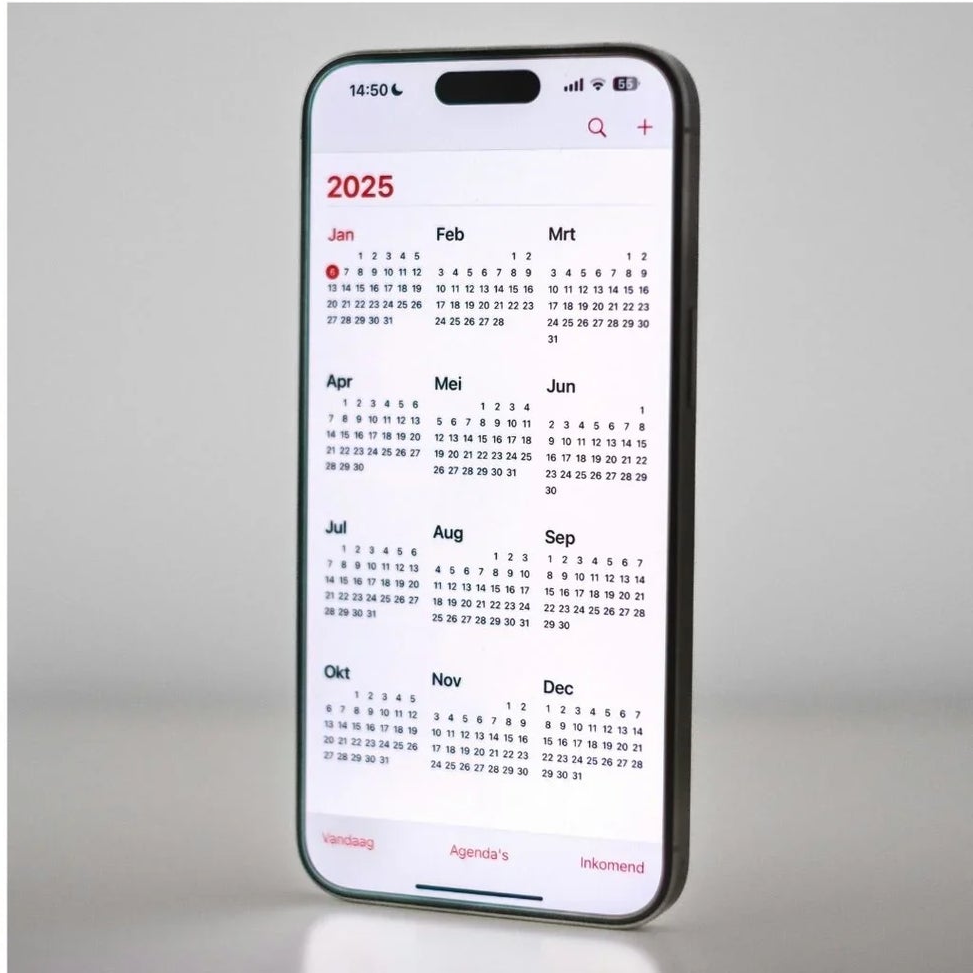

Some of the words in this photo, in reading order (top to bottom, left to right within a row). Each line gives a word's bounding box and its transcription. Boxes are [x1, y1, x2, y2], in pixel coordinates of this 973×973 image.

[350, 83, 388, 97] 14:50
[327, 175, 394, 198] 2025
[328, 228, 354, 242] Jan
[437, 227, 465, 241] Feb
[549, 227, 576, 241] Mrt
[372, 252, 377, 260] 2
[386, 252, 392, 260] 3
[400, 252, 406, 260] 4
[414, 252, 420, 260] 5
[526, 252, 532, 261] 2
[641, 252, 647, 261] 2
[438, 268, 444, 277] 3
[452, 268, 459, 276] 4
[467, 268, 473, 277] 5
[481, 268, 488, 277] 6
[496, 268, 502, 277] 7
[510, 268, 517, 277] 8
[525, 268, 532, 277] 9
[548, 285, 559, 294] 10
[564, 285, 572, 293] 11
[578, 285, 588, 294] 12
[593, 285, 604, 294] 13
[608, 286, 619, 294] 14
[624, 285, 634, 295] 15
[639, 286, 649, 295] 16
[327, 299, 338, 309] 20
[341, 300, 351, 309] 21
[355, 300, 366, 309] 22
[369, 300, 380, 309] 23
[383, 300, 394, 309] 24
[397, 300, 408, 309] 25
[411, 300, 422, 309] 26
[435, 317, 446, 325] 24
[449, 317, 461, 326] 25
[464, 317, 475, 326] 26
[479, 317, 489, 326] 27
[493, 317, 504, 326] 28
[548, 335, 558, 344] 31
[326, 374, 353, 391] Apr
[435, 376, 462, 391] Mei
[546, 379, 575, 393] Jun
[357, 398, 362, 407] 2
[370, 399, 376, 408] 3
[384, 400, 390, 408] 4
[398, 400, 404, 409] 5
[412, 400, 419, 409] 6
[495, 402, 500, 411] 2
[509, 403, 515, 411] 3
[524, 403, 530, 411] 4
[549, 420, 555, 429] 2
[564, 420, 570, 429] 3
[578, 421, 585, 429] 4
[594, 421, 600, 430] 5
[608, 422, 615, 431] 6
[624, 422, 630, 431] 7
[639, 423, 645, 432] 8
[435, 433, 444, 442] 12
[449, 434, 459, 442] 13
[463, 434, 473, 442] 14
[478, 435, 488, 443] 15
[492, 435, 502, 444] 16
[507, 435, 517, 444] 17
[521, 436, 532, 445] 18
[546, 453, 557, 462] 16
[561, 454, 571, 462] 17
[576, 454, 587, 463] 18
[591, 454, 602, 464] 19
[605, 455, 617, 464] 20
[621, 455, 631, 464] 21
[636, 456, 647, 465] 22
[545, 486, 557, 495] 30
[325, 520, 347, 534] Jul
[433, 525, 463, 543] Aug
[545, 530, 575, 548] Sep
[355, 545, 361, 554] 2
[369, 546, 375, 555] 3
[383, 547, 389, 555] 4
[397, 547, 403, 556] 5
[411, 548, 417, 557] 6
[508, 552, 513, 561] 2
[522, 553, 528, 562] 3
[562, 555, 568, 564] 2
[577, 556, 583, 565] 3
[592, 557, 598, 565] 4
[607, 557, 613, 566] 5
[622, 558, 628, 567] 6
[637, 559, 643, 567] 7
[435, 565, 441, 573] 4
[449, 566, 455, 575] 5
[463, 567, 470, 575] 6
[478, 567, 484, 576] 7
[492, 568, 499, 577] 8
[507, 569, 513, 578] 9
[520, 570, 530, 579] 10
[544, 604, 555, 613] 22
[559, 604, 570, 613] 23
[573, 605, 585, 614] 24
[588, 606, 600, 615] 25
[603, 607, 615, 616] 26
[619, 608, 630, 617] 27
[633, 608, 645, 618] 28
[432, 613, 443, 622] 25
[446, 614, 458, 623] 26
[461, 615, 472, 624] 27
[475, 616, 487, 625] 28
[490, 616, 501, 626] 29
[504, 617, 516, 627] 30
[519, 618, 529, 627] 31
[544, 620, 555, 629] 29
[558, 620, 570, 630] 30
[324, 664, 350, 680] Okt
[432, 672, 462, 687] Nov
[543, 680, 574, 695] Dec
[368, 691, 374, 700] 2
[382, 693, 388, 701] 3
[410, 694, 416, 703] 5
[521, 702, 526, 711] 2
[560, 705, 566, 714] 2
[575, 706, 581, 715] 3
[590, 708, 596, 716] 4
[605, 708, 611, 717] 5
[619, 709, 626, 718] 6
[635, 710, 641, 719] 7
[432, 728, 442, 737] 10
[446, 729, 455, 737] 11
[460, 730, 470, 739] 12
[475, 731, 485, 741] 13
[489, 733, 499, 741] 14
[504, 734, 514, 743] 15
[518, 735, 528, 744] 16
[542, 769, 553, 778] 29
[557, 770, 568, 779] 30
[572, 771, 582, 780] 31
[322, 831, 375, 850] Vandaag
[450, 844, 509, 861] Agenda's
[581, 857, 645, 874] Inkomend
